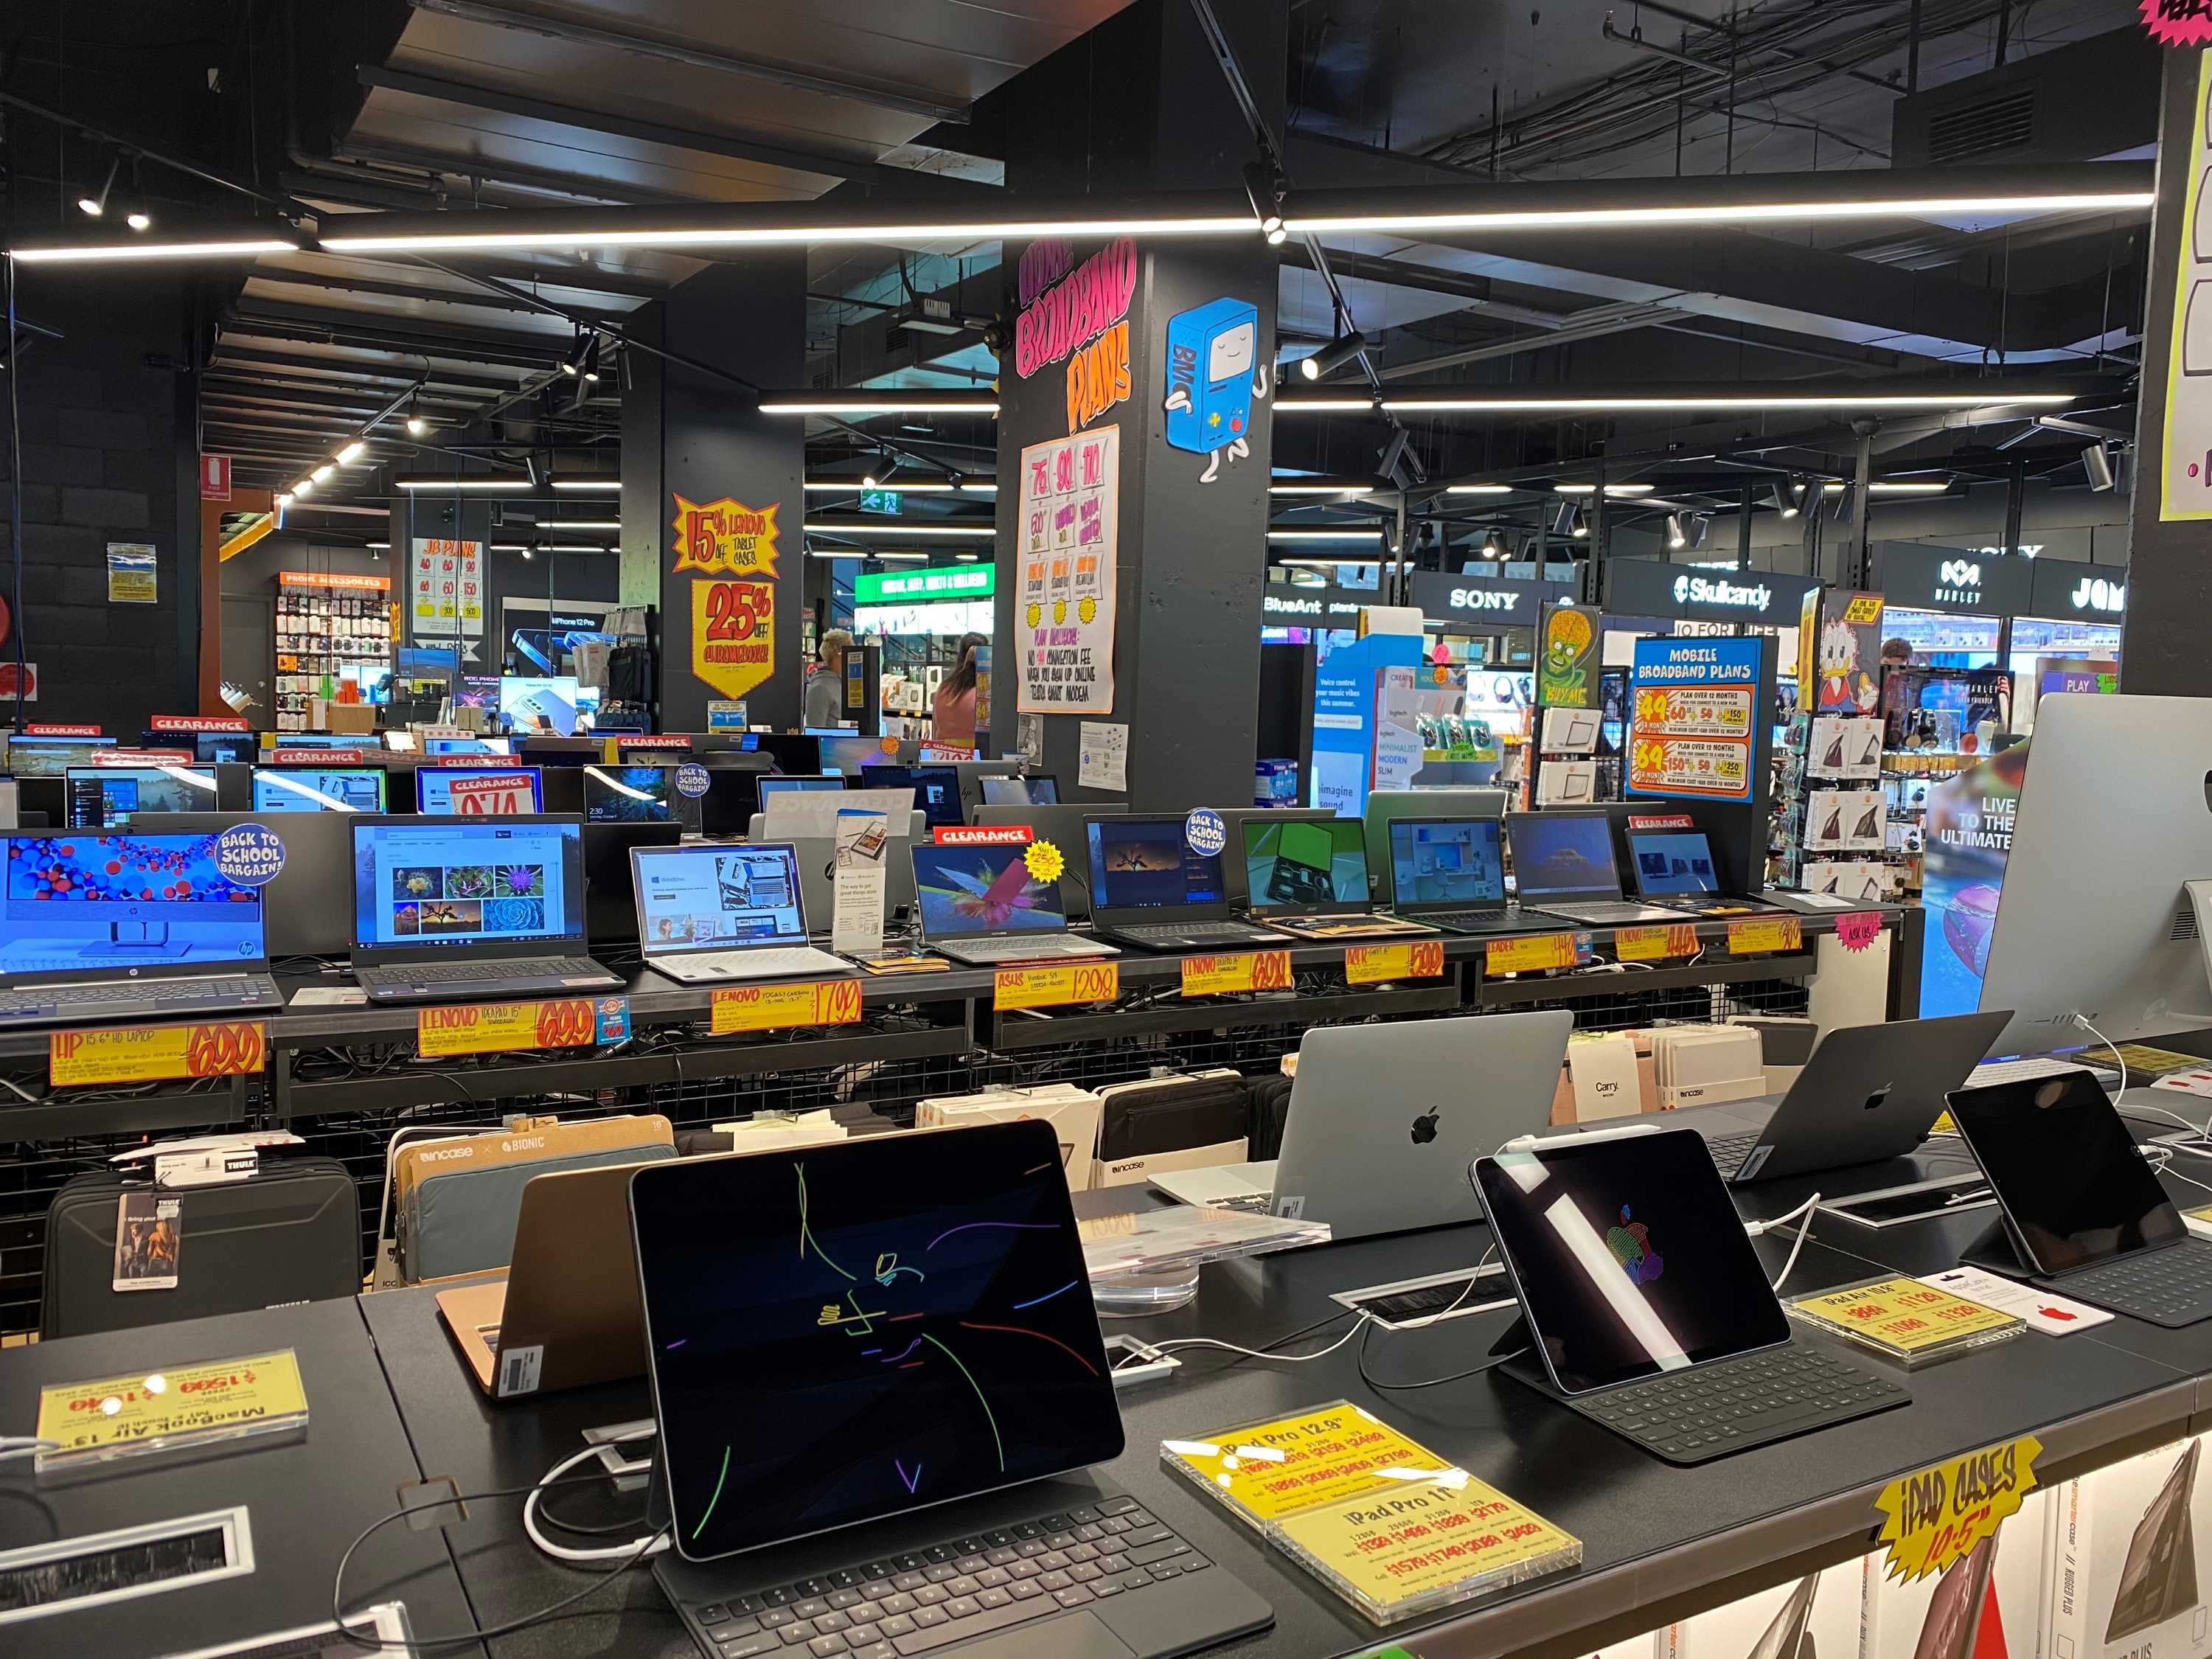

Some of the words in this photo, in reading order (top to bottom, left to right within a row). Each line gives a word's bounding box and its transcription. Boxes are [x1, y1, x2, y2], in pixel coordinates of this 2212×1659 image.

[1016, 236, 1137, 379] BROADBAND
[1067, 320, 1131, 436] PLANS
[1083, 443, 1099, 485] 110
[686, 508, 727, 563] 15%
[728, 513, 766, 536] LENOVO
[732, 536, 758, 550] TABLET
[422, 539, 441, 554] JB
[441, 541, 476, 558] PLANS
[733, 552, 757, 566] CASES
[286, 575, 315, 584] PHONE
[318, 575, 380, 586] ACCESSORIES
[1264, 596, 1322, 614] BlueAnt
[1450, 588, 1520, 610] SONY
[706, 582, 771, 641] 25%
[1699, 623, 1730, 636] FOR
[703, 644, 770, 664] CHROMEBOOKS
[1029, 649, 1034, 666] NO
[1080, 648, 1091, 665] FEE
[1669, 648, 1717, 663] MOBILE
[1074, 666, 1096, 682] ONLINE
[1638, 665, 1705, 679] BROADBAND
[1711, 664, 1751, 679] PLANS
[1321, 678, 1338, 686] Voice
[2067, 680, 2090, 693] PLAY
[1066, 683, 1090, 702] MODEM
[1328, 689, 1345, 697] music
[1346, 689, 1360, 697] vibes
[1545, 686, 1567, 704] BUY
[1568, 686, 1587, 704] ME
[1670, 707, 1686, 720] 60
[33, 726, 96, 735] CLEARANCE
[156, 719, 244, 731] CLEARANCE
[620, 737, 689, 747] CLEARANCE
[1379, 744, 1417, 753] MINIMALIST
[1677, 742, 1691, 751] PLAN
[1713, 744, 1735, 752] MONTHS
[280, 753, 356, 763] CLEARANCE
[1379, 756, 1408, 765] MODERN
[1635, 742, 1663, 771] 69
[1668, 757, 1685, 771] 150
[678, 768, 696, 776] BACK
[698, 769, 708, 778] TO
[1378, 767, 1394, 776] SLIM
[455, 777, 524, 790] CLEARANCE
[678, 776, 708, 785] SCHOOL
[678, 784, 709, 793] BARGAIN!
[1319, 801, 1343, 811] sound
[1982, 797, 2017, 814] LIVE
[1190, 815, 1211, 827] BACK
[1213, 820, 1224, 831] TO
[1635, 818, 1689, 828] CLEARANCE
[1958, 813, 1980, 830] TO
[1984, 815, 2014, 832] THE
[220, 834, 256, 848] BACK
[260, 832, 279, 847] TO
[942, 830, 1026, 842] CLEARANCE
[1190, 826, 1224, 840] SCHOOL
[1941, 829, 2012, 849] ULTIMATE
[1188, 835, 1224, 849] BARGAIN!
[221, 847, 280, 863] SCHOOL
[219, 860, 284, 876] BARGAIN!
[1488, 940, 1515, 953] LEADER
[1346, 947, 1368, 965] ACER
[1183, 959, 1216, 976] LENOVO
[998, 972, 1024, 989] ASUS
[1072, 967, 1113, 1000] 1298
[714, 988, 761, 1004] LENOVO
[815, 981, 860, 1023] 1799
[422, 1008, 479, 1029] LENOVO
[481, 1006, 508, 1018] IDEAPAD
[511, 1006, 521, 1017] 15"
[536, 1001, 593, 1047] 699
[56, 1033, 83, 1059] HP
[86, 1033, 110, 1046] 15.6"
[111, 1033, 123, 1044] HD
[126, 1030, 154, 1043] LAPTOP
[188, 1022, 261, 1076] 699
[1596, 1081, 1619, 1093] Carry.
[430, 1146, 474, 1161] incase
[512, 1136, 545, 1152] BIONIC
[226, 1161, 256, 1170] THULE
[1119, 1161, 1145, 1173] incase
[1823, 1295, 1848, 1306] iPad
[1851, 1290, 1868, 1301] Air
[155, 1406, 265, 1433] MacBook
[113, 1423, 149, 1439] Air
[1262, 1431, 1300, 1446] Pro
[1299, 1416, 1343, 1436] 12.9"
[1901, 1474, 1947, 1538] iPAD
[1952, 1443, 2017, 1517] CASES
[1344, 1503, 1388, 1526] iPad
[1388, 1498, 1430, 1514] Pro
[1385, 1557, 1429, 1577] $1579
[2065, 1568, 2075, 1593] RUGGED
[2063, 1596, 2073, 1616] PLUS
